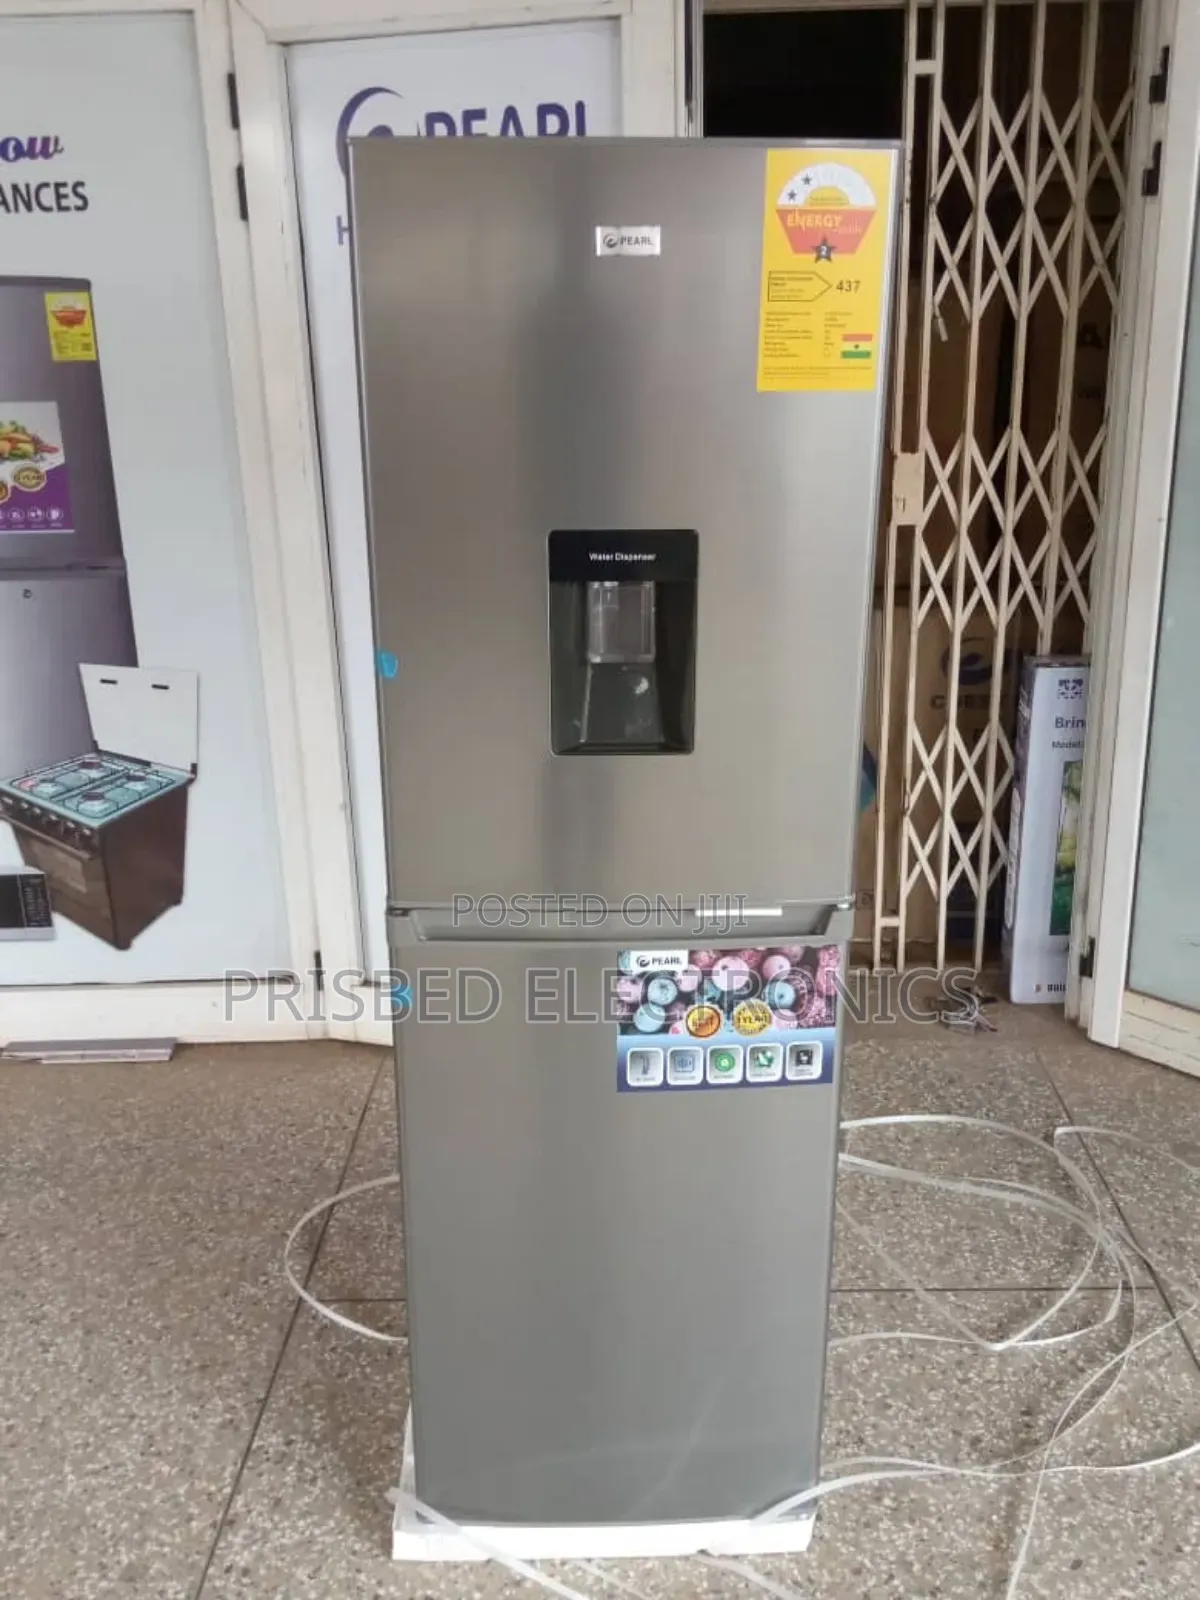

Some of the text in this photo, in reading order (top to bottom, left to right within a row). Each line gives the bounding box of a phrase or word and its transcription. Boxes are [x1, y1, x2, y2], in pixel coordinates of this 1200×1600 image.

[620, 235, 653, 247] PEARL
[836, 279, 860, 294] 437
[588, 552, 613, 562] Water
[652, 956, 681, 966] PEARL
